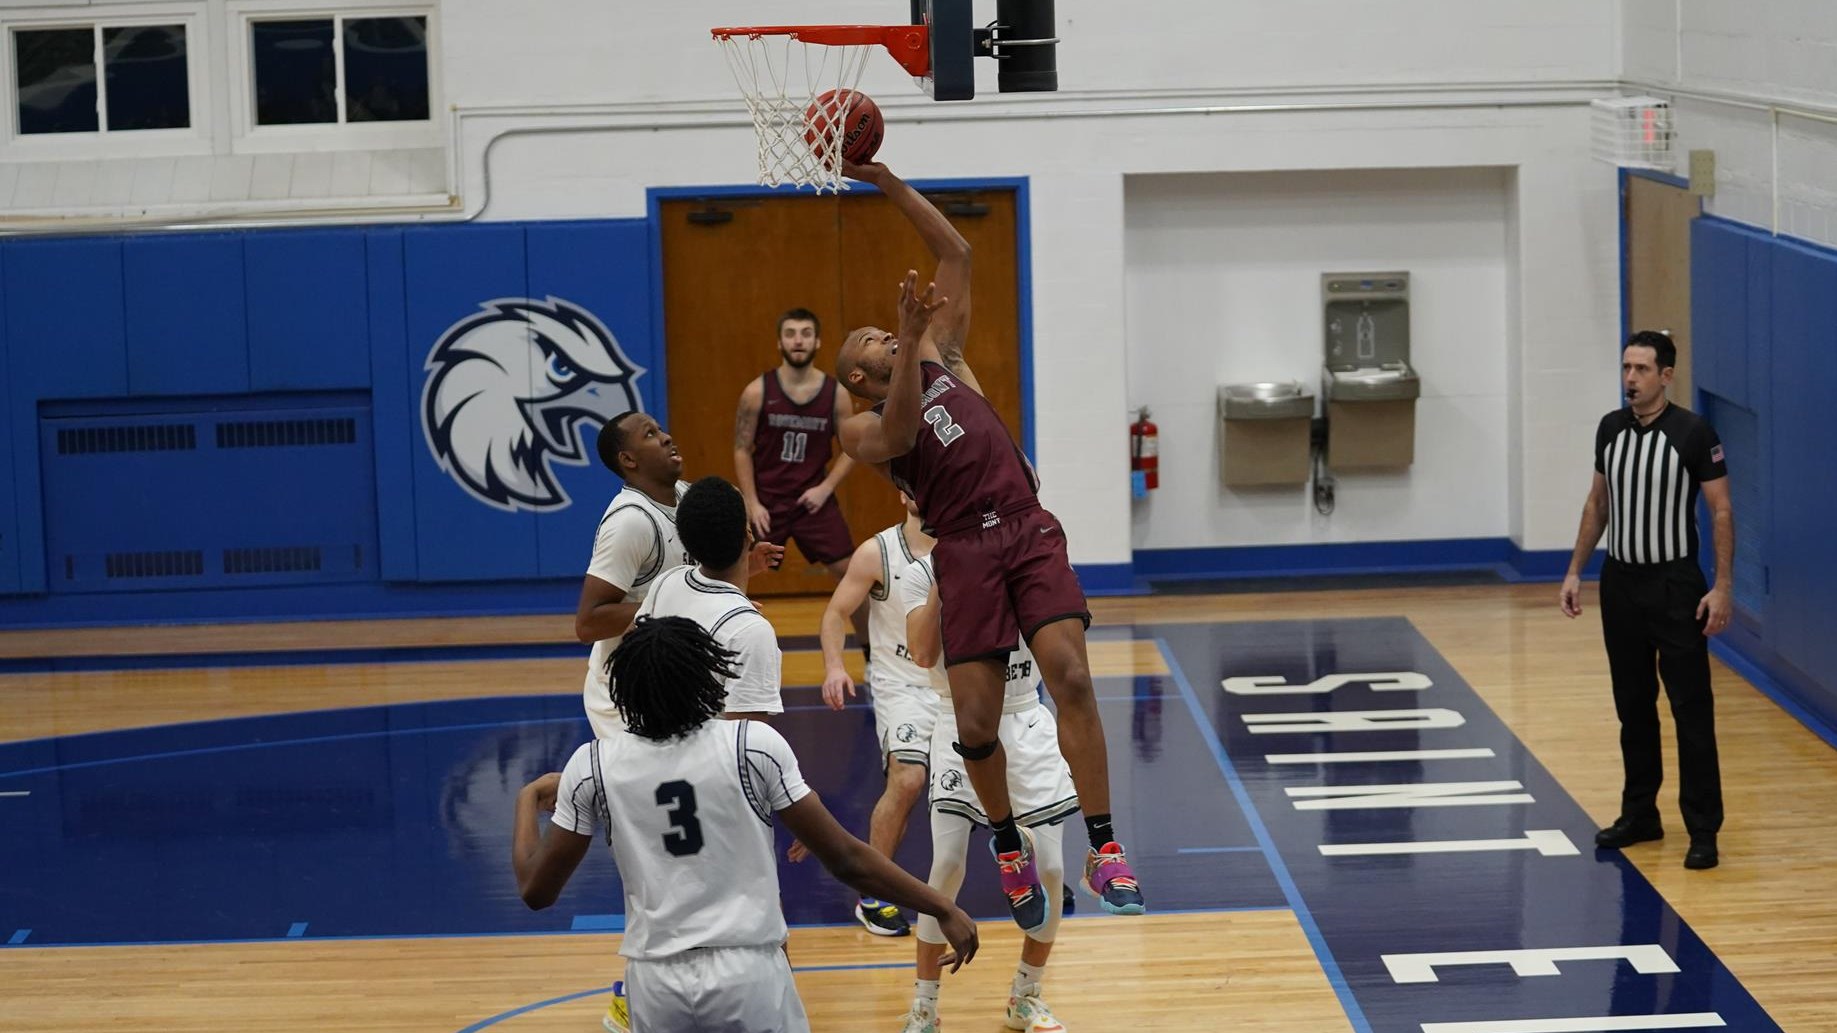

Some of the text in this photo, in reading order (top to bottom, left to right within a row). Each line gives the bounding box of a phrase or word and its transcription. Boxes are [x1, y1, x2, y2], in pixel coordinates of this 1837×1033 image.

[923, 405, 965, 448] 2
[780, 431, 808, 463] 11
[982, 511, 998, 521] THE
[982, 517, 1001, 529] MONT
[1221, 671, 1581, 857] SAINT
[655, 779, 704, 857] 3
